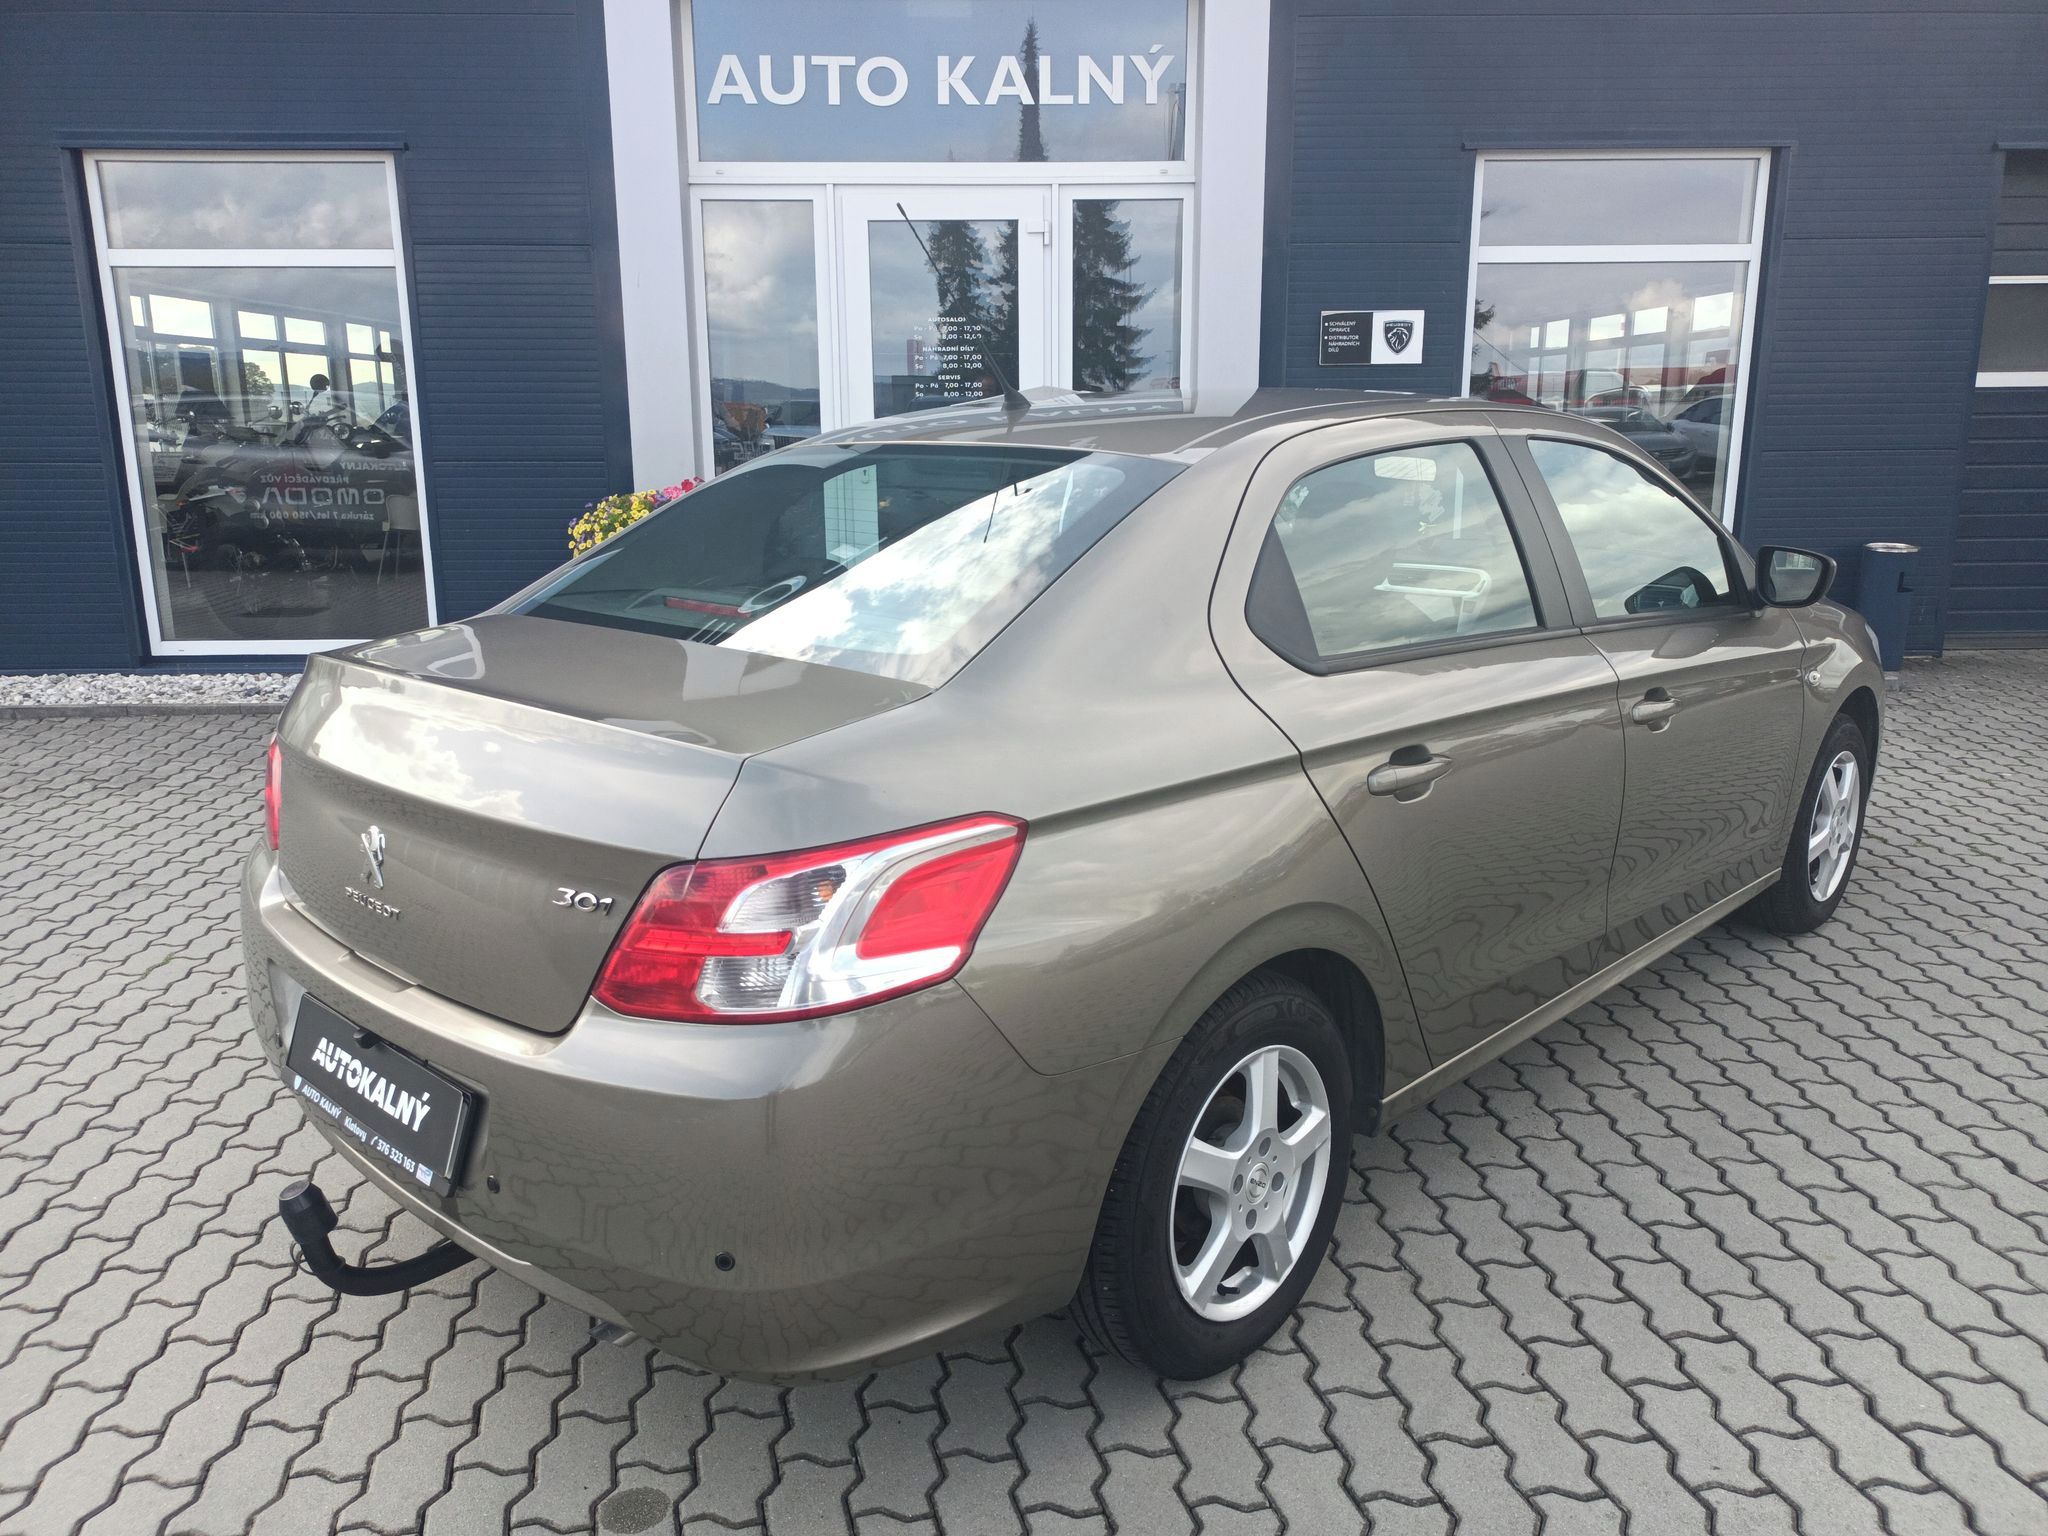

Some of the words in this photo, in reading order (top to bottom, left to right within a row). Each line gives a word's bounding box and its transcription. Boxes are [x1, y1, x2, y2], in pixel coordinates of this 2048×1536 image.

[707, 54, 908, 107] AUTO
[937, 44, 1175, 105] KALNÝ
[964, 362, 982, 370] 12,00
[345, 886, 401, 920] PEUGEOT
[552, 887, 614, 916] 301
[311, 1037, 431, 1132] AUTOKALNÝ
[302, 1084, 320, 1103] AUTO
[320, 1096, 342, 1119] KALNÝ
[377, 1139, 390, 1155] 376
[390, 1148, 403, 1164] 323
[403, 1156, 416, 1172] 163
